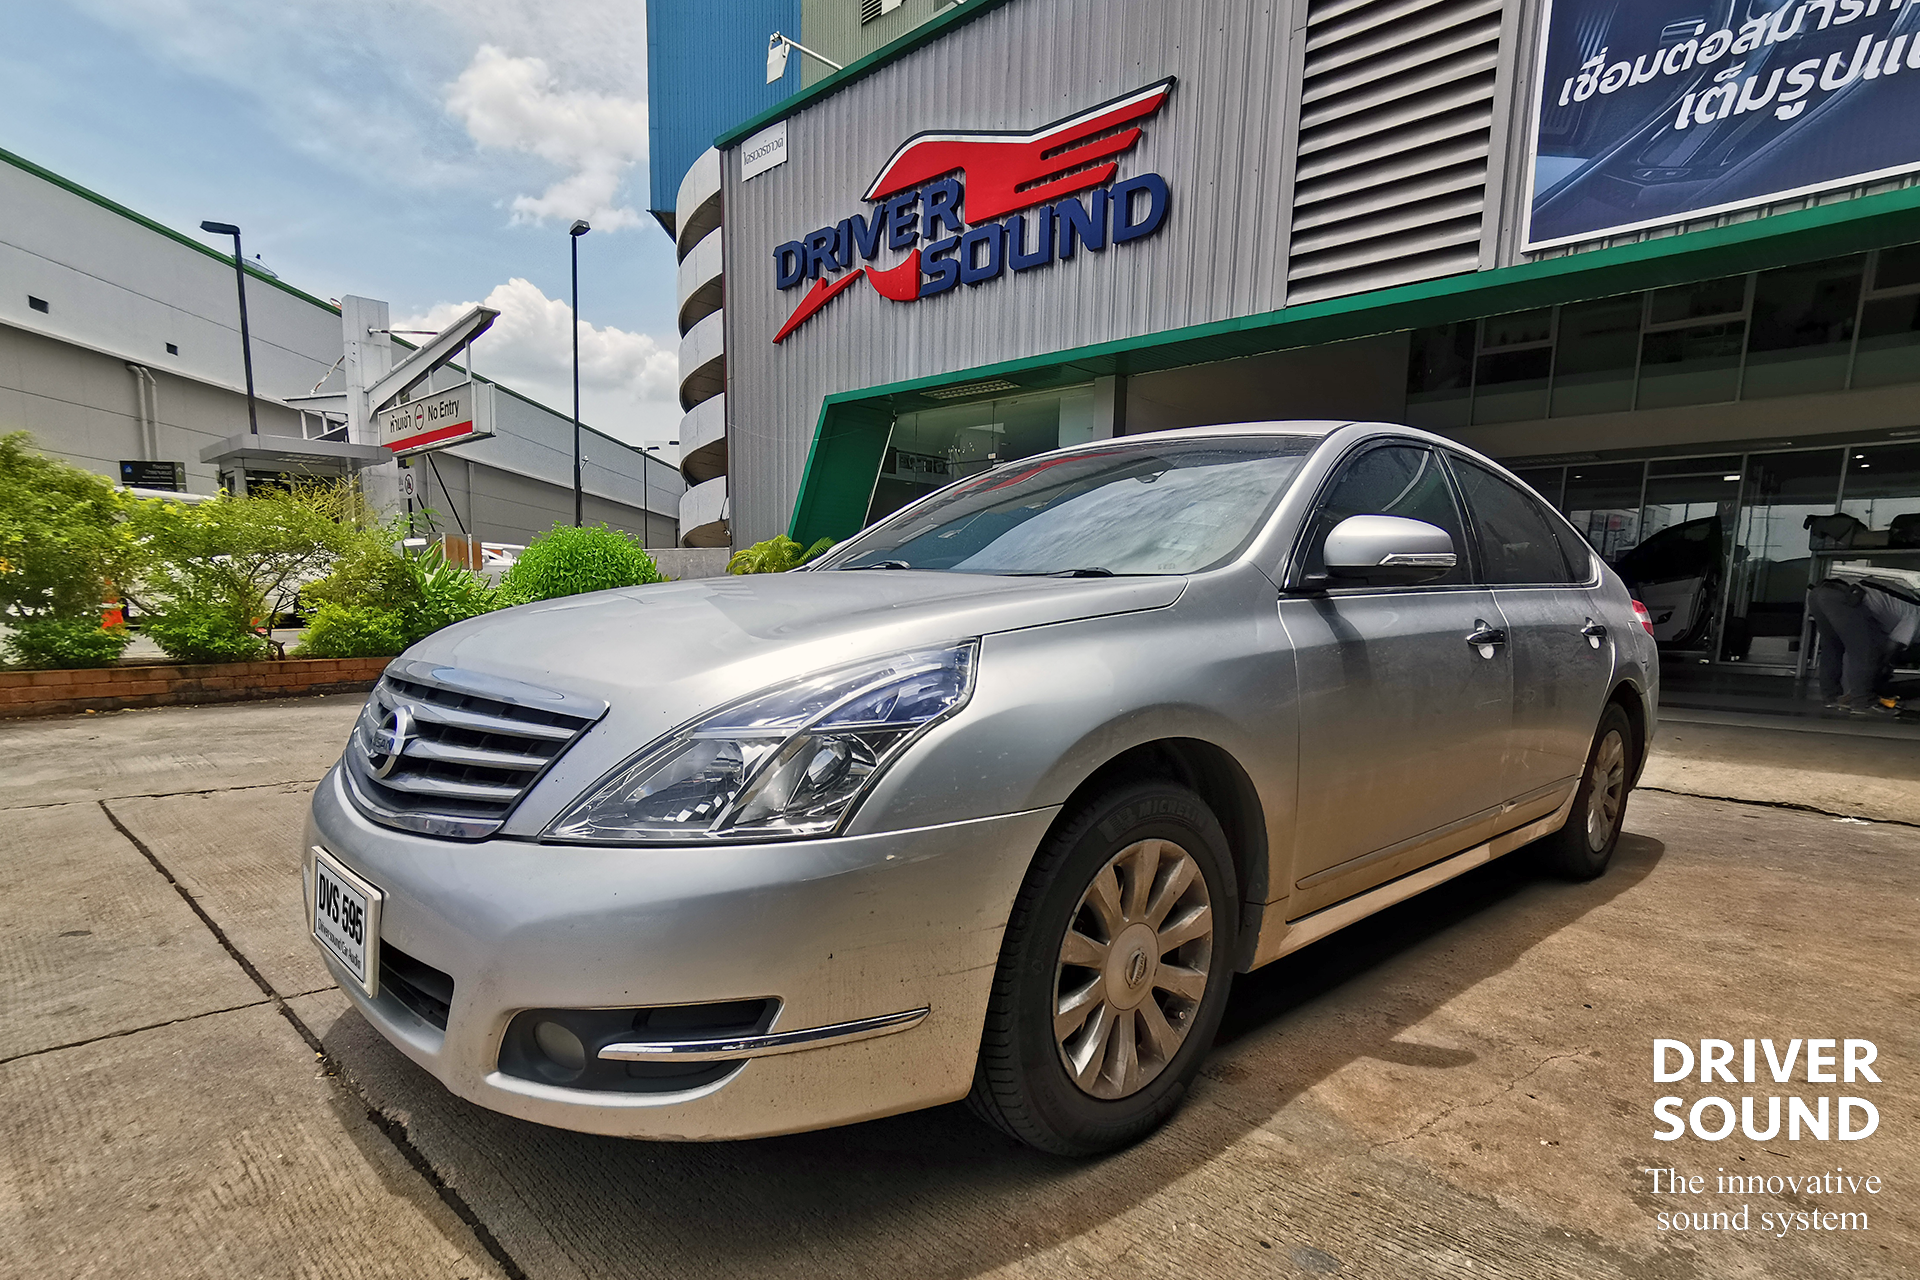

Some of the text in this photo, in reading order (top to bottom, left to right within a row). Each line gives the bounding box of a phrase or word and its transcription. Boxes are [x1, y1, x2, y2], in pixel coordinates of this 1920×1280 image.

[1558, 0, 1920, 107] เชื่อมต่อสมาร
[773, 178, 963, 291] DRIVER
[918, 172, 1171, 297] SOUND
[427, 399, 460, 421] No Entry
[318, 872, 363, 946] DVS 595
